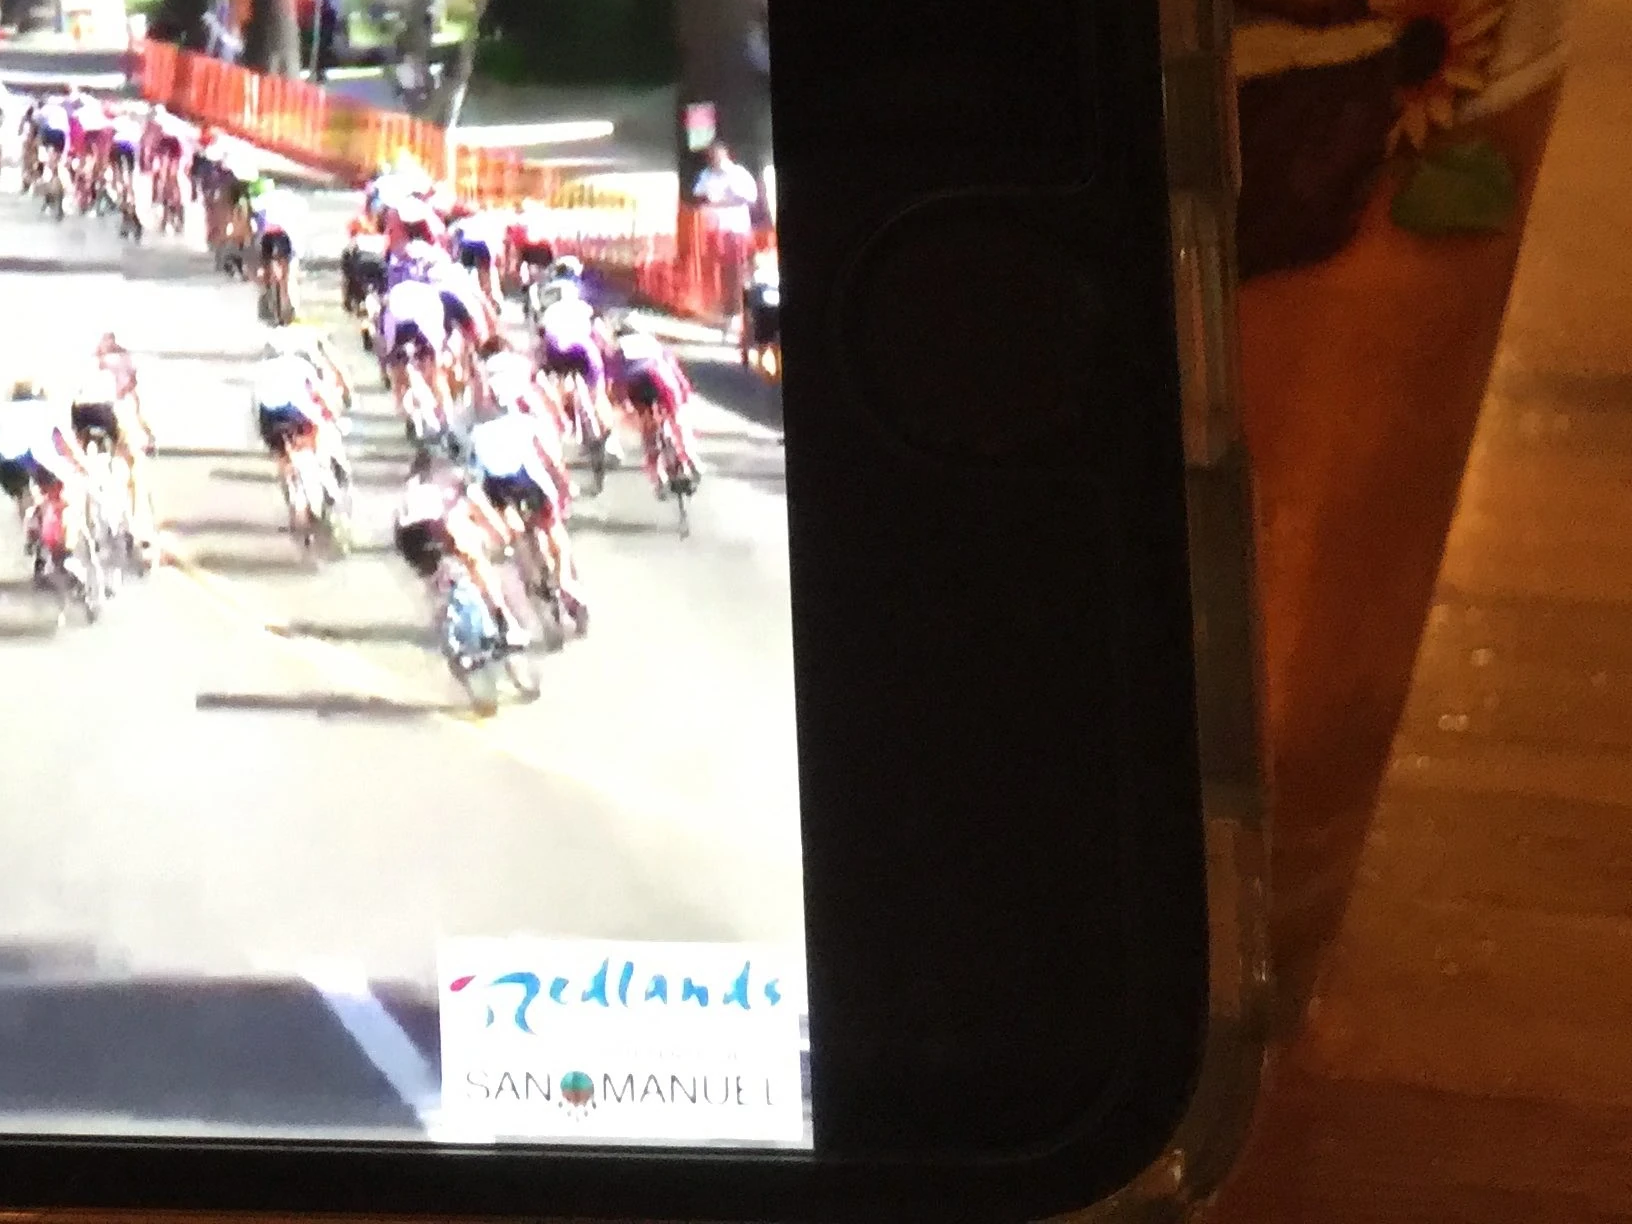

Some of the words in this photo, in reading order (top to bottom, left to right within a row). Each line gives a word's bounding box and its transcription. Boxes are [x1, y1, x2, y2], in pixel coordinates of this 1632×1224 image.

[451, 956, 782, 1035] Redlands
[466, 1070, 551, 1102] SAN
[603, 1072, 774, 1105] MANUEL
